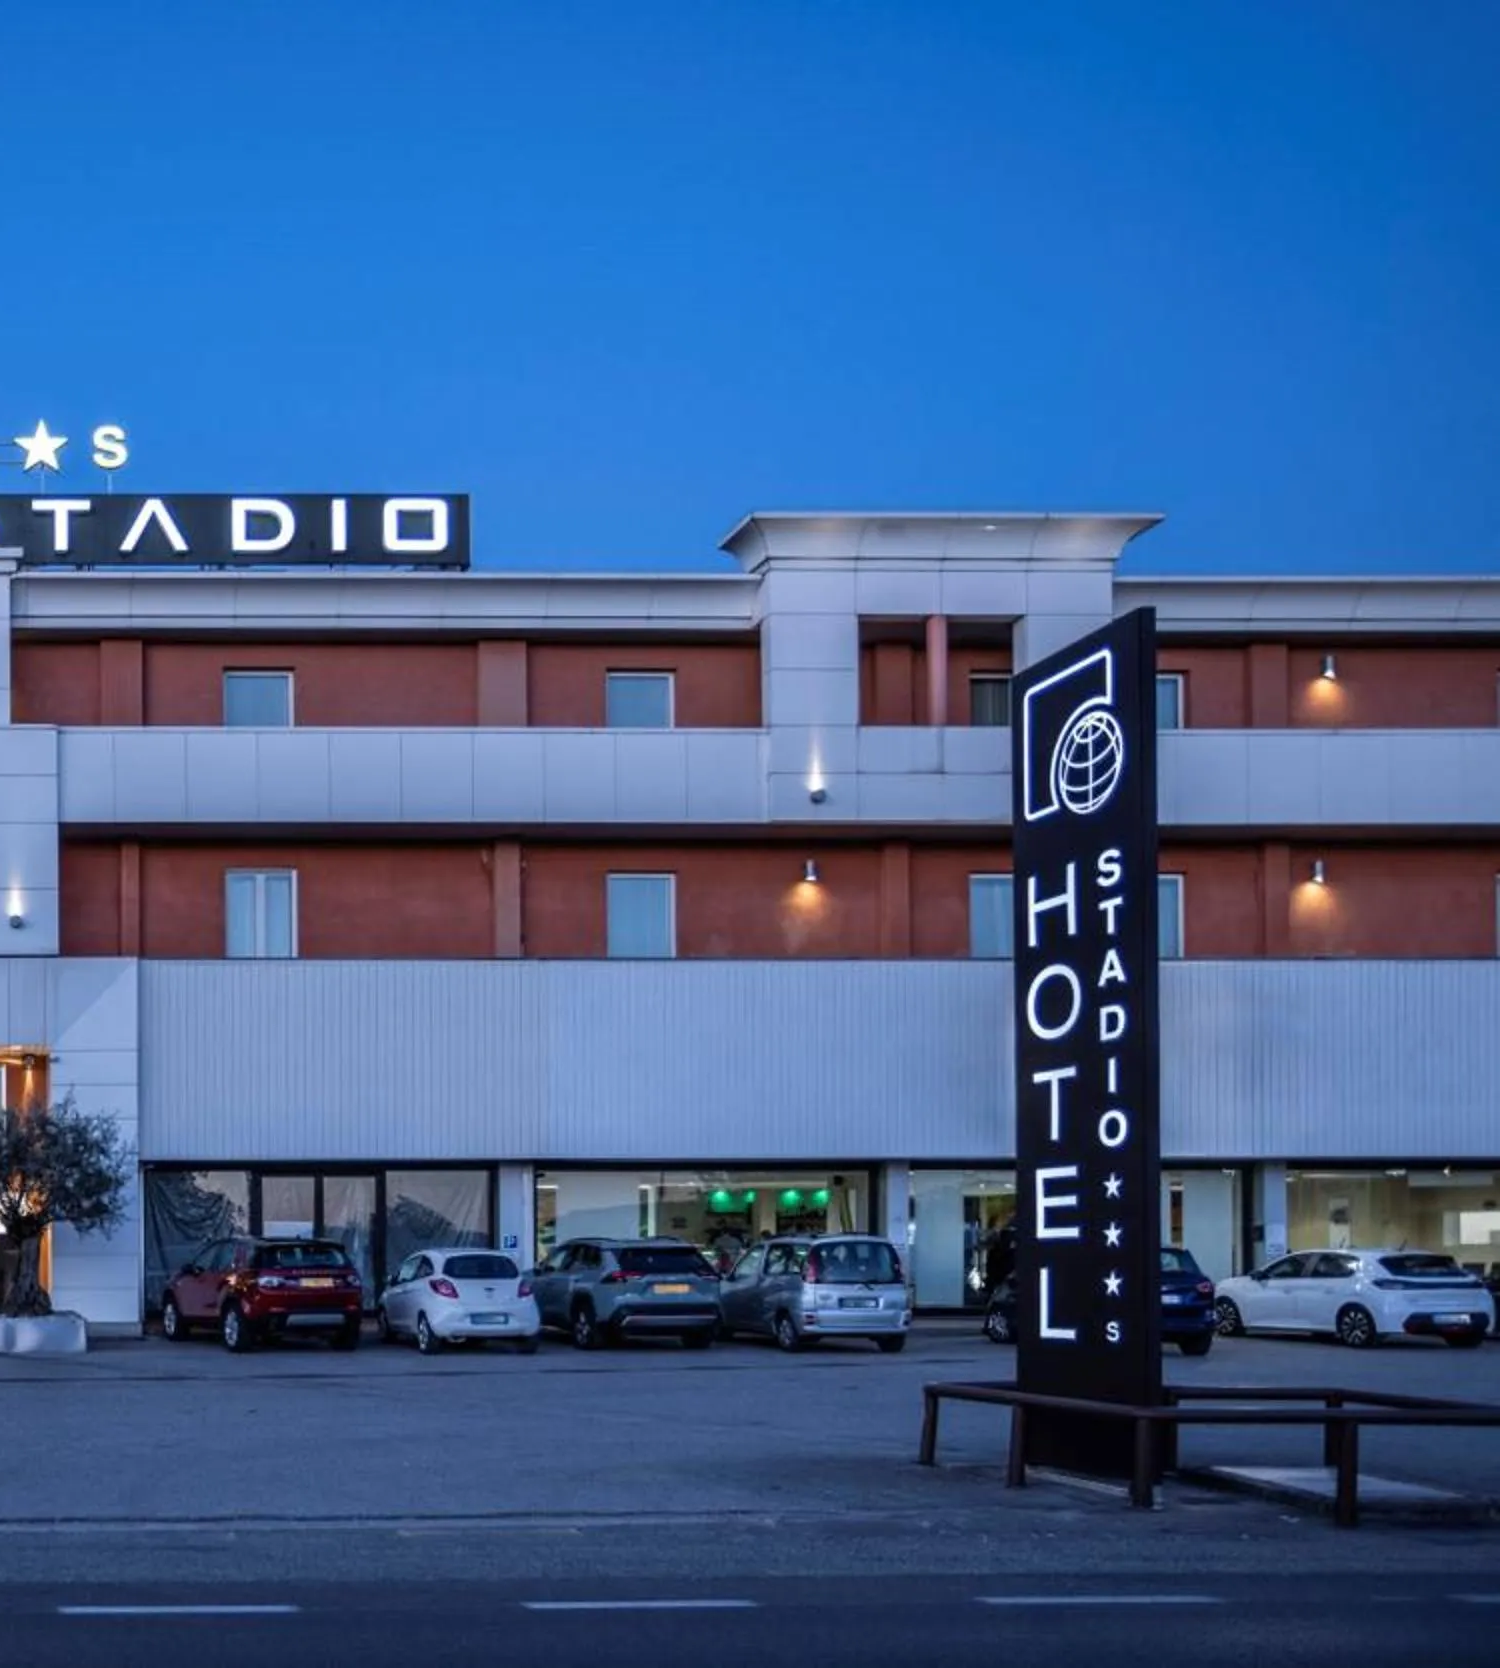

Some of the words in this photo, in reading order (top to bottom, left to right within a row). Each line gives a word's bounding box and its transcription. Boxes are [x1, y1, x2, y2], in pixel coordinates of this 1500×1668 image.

[92, 424, 129, 469] S
[1025, 860, 1083, 1342] HOTEL
[1095, 847, 1129, 1149] STADIO
